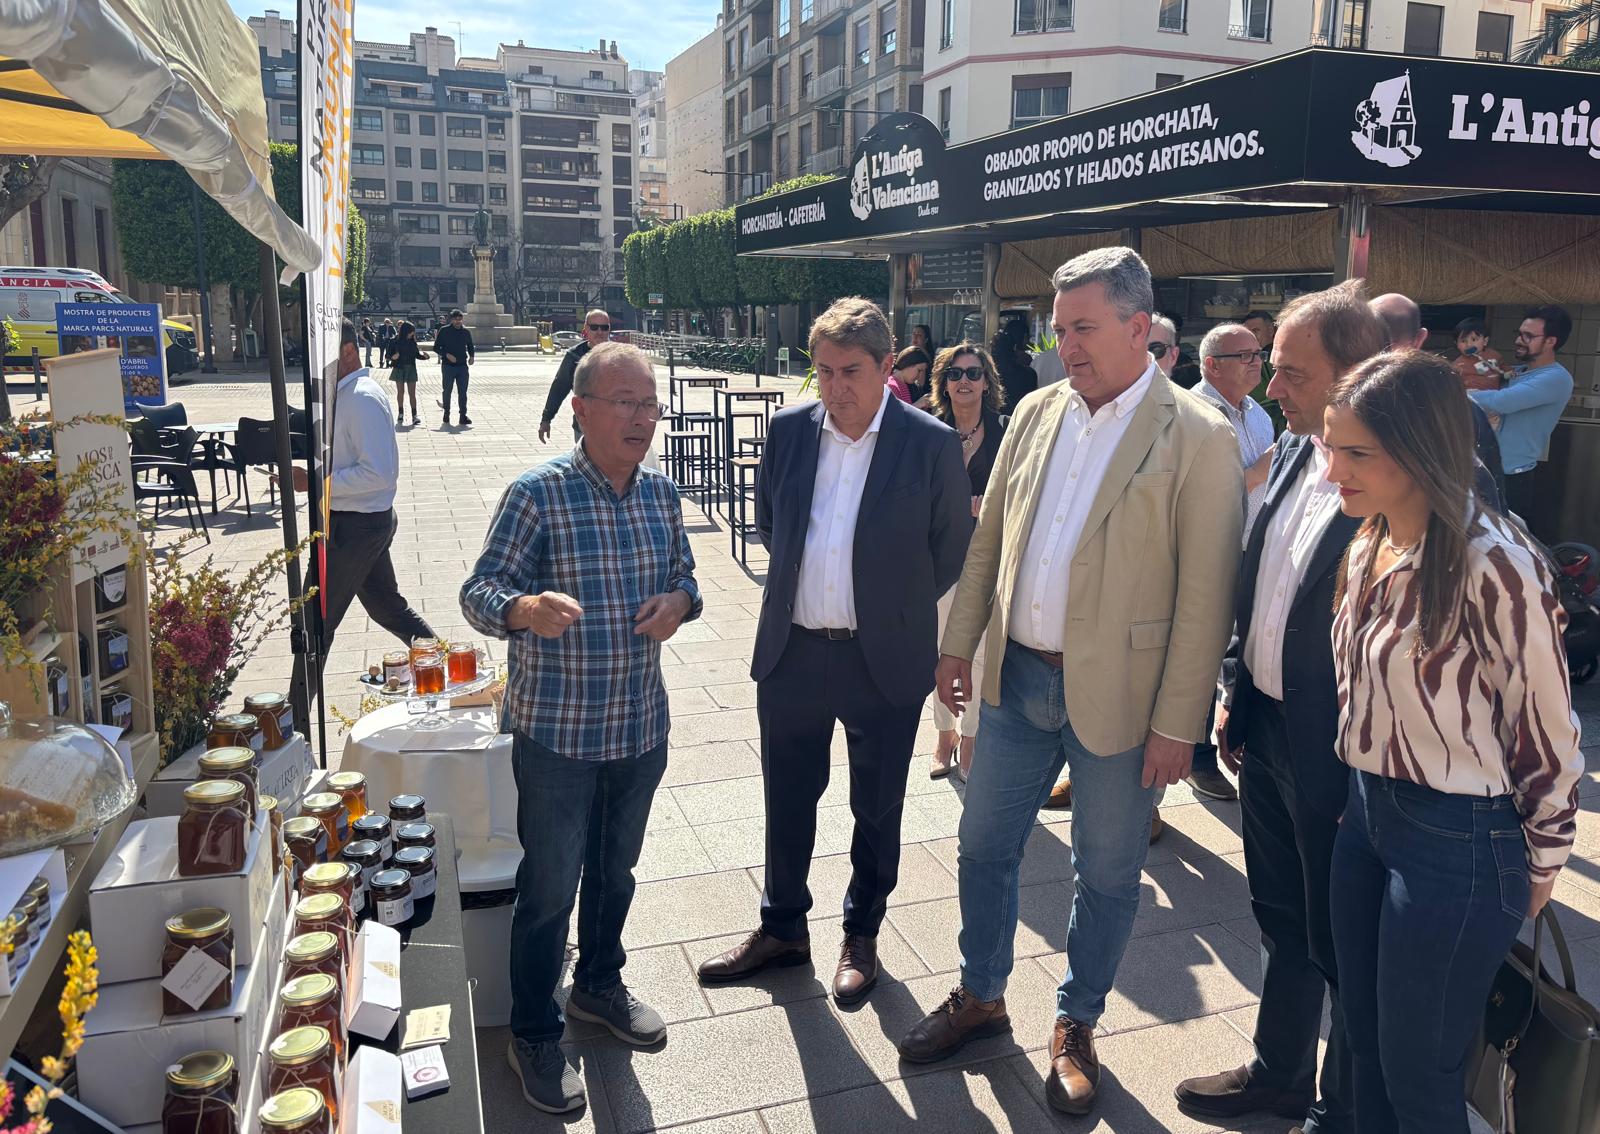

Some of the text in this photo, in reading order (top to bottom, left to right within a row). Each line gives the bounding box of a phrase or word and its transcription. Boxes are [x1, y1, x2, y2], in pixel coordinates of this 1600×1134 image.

[984, 102, 1219, 174] OBRADOR PROPIO DE HORCHATA,
[872, 144, 924, 179] L'Antiga
[983, 129, 1265, 201] GRANIZADOS Y HELADOS ARTESANOS.
[871, 177, 940, 210] Valenciana
[741, 206, 783, 235] HORCHATERÍA
[788, 196, 826, 227] CAFETERÍA
[107, 309, 151, 317] PRODUCTES
